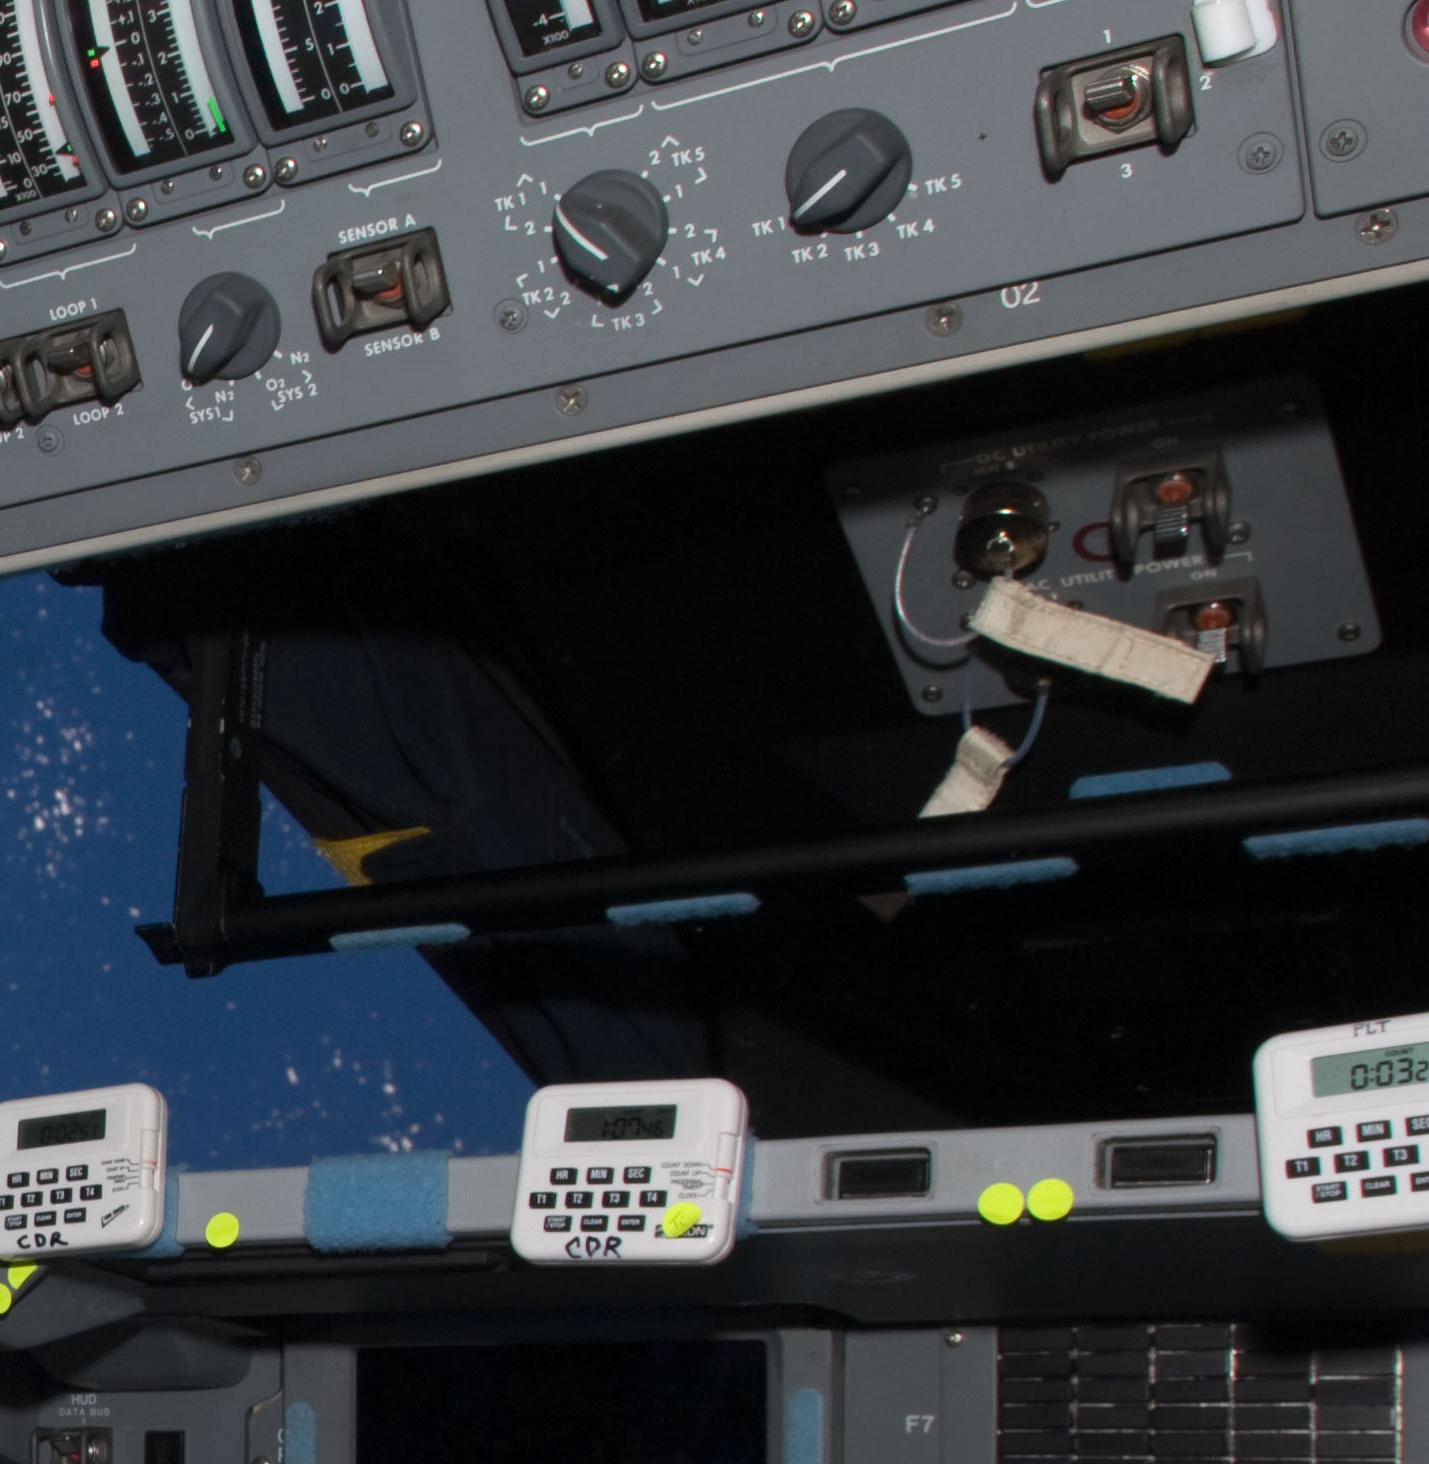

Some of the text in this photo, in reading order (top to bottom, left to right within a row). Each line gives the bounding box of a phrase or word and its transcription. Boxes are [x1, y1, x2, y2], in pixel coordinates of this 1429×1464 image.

[1102, 28, 1111, 44] 1
[1200, 75, 1212, 91] 2
[4, 92, 22, 107] 70
[17, 130, 34, 144] 50
[1120, 163, 1133, 178] 3
[925, 173, 962, 195] TK 5
[338, 213, 417, 244] SENSOR A
[751, 216, 786, 237] TK 1
[896, 219, 935, 240] TK 4
[791, 243, 829, 263] TK 2
[844, 242, 880, 261] TK 3
[49, 298, 97, 321] LOOP 1
[364, 327, 440, 357] SENSOR B
[73, 404, 125, 426] LOOP 2
[15, 427, 25, 441] 2
[1134, 553, 1204, 575] POWER
[1191, 568, 1218, 581] ON
[1353, 1020, 1391, 1037] PLT
[1315, 1130, 1332, 1142] HR
[1362, 1123, 1384, 1136] MIN
[556, 1169, 569, 1180] HR
[590, 1168, 607, 1179] MIN
[627, 1167, 645, 1179] SEC
[17, 1231, 69, 1250] CDR
[565, 1236, 622, 1258] CDR
[72, 1394, 96, 1406] HUD
[905, 1415, 934, 1433] F7
